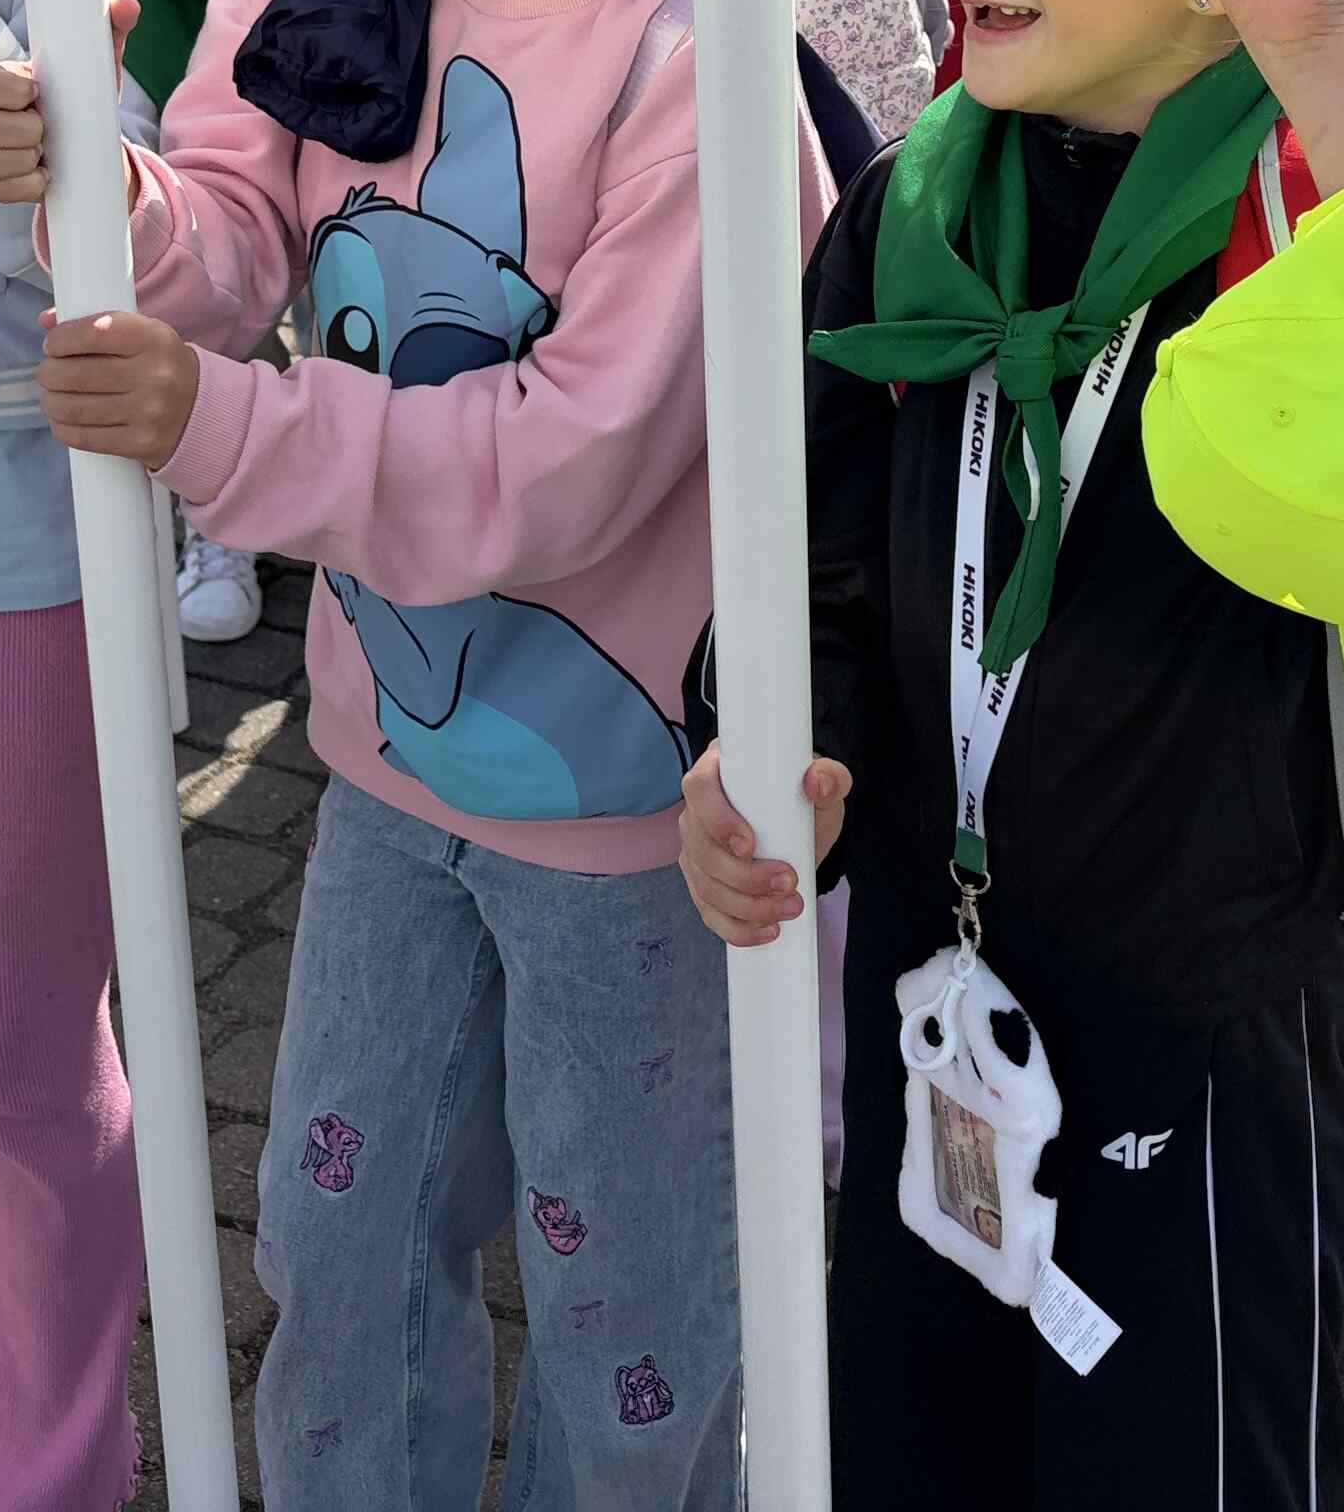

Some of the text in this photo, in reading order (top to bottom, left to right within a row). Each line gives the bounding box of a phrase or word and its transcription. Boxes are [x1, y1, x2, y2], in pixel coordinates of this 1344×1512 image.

[969, 391, 989, 477] HiKOKI
[961, 562, 976, 650] HiKOKI
[1100, 1128, 1174, 1170] 4F
